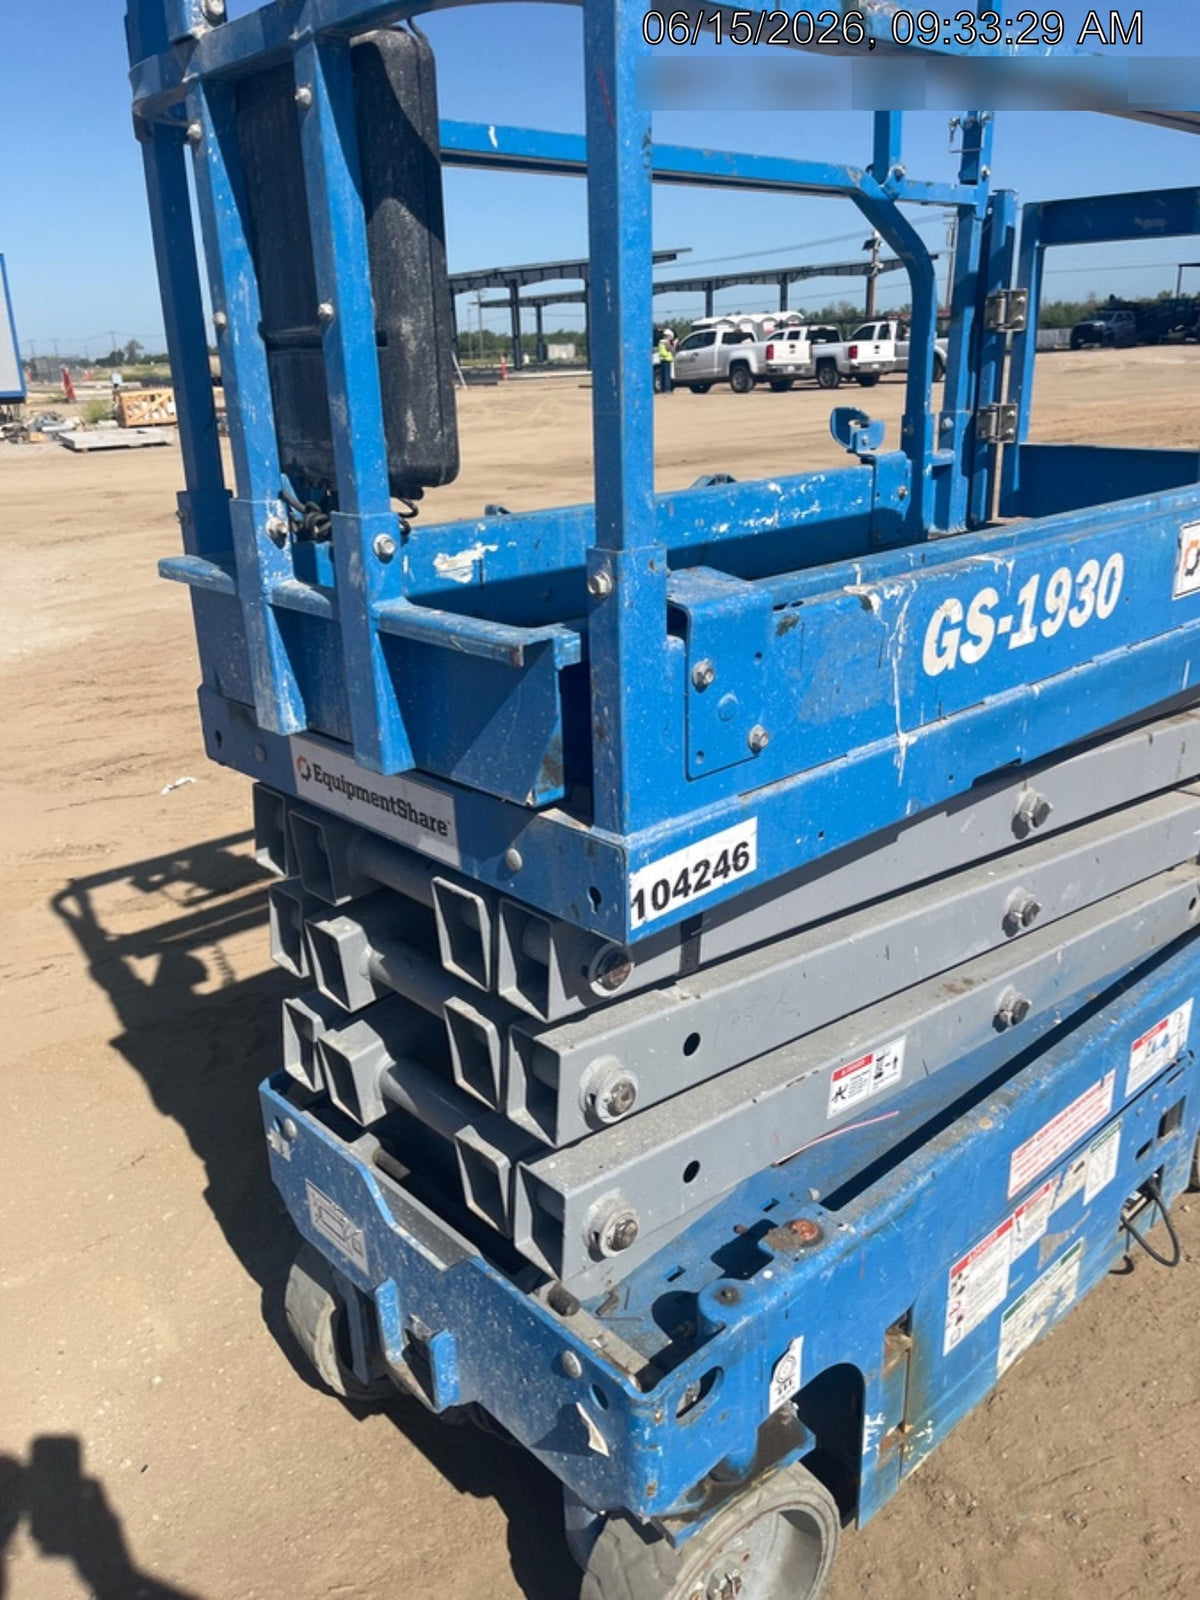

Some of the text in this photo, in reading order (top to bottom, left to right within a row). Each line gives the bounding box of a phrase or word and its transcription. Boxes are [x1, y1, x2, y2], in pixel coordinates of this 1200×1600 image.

[921, 552, 1126, 677] GS-1930
[312, 763, 449, 838] EquipmentShare
[630, 841, 750, 921] 104246
